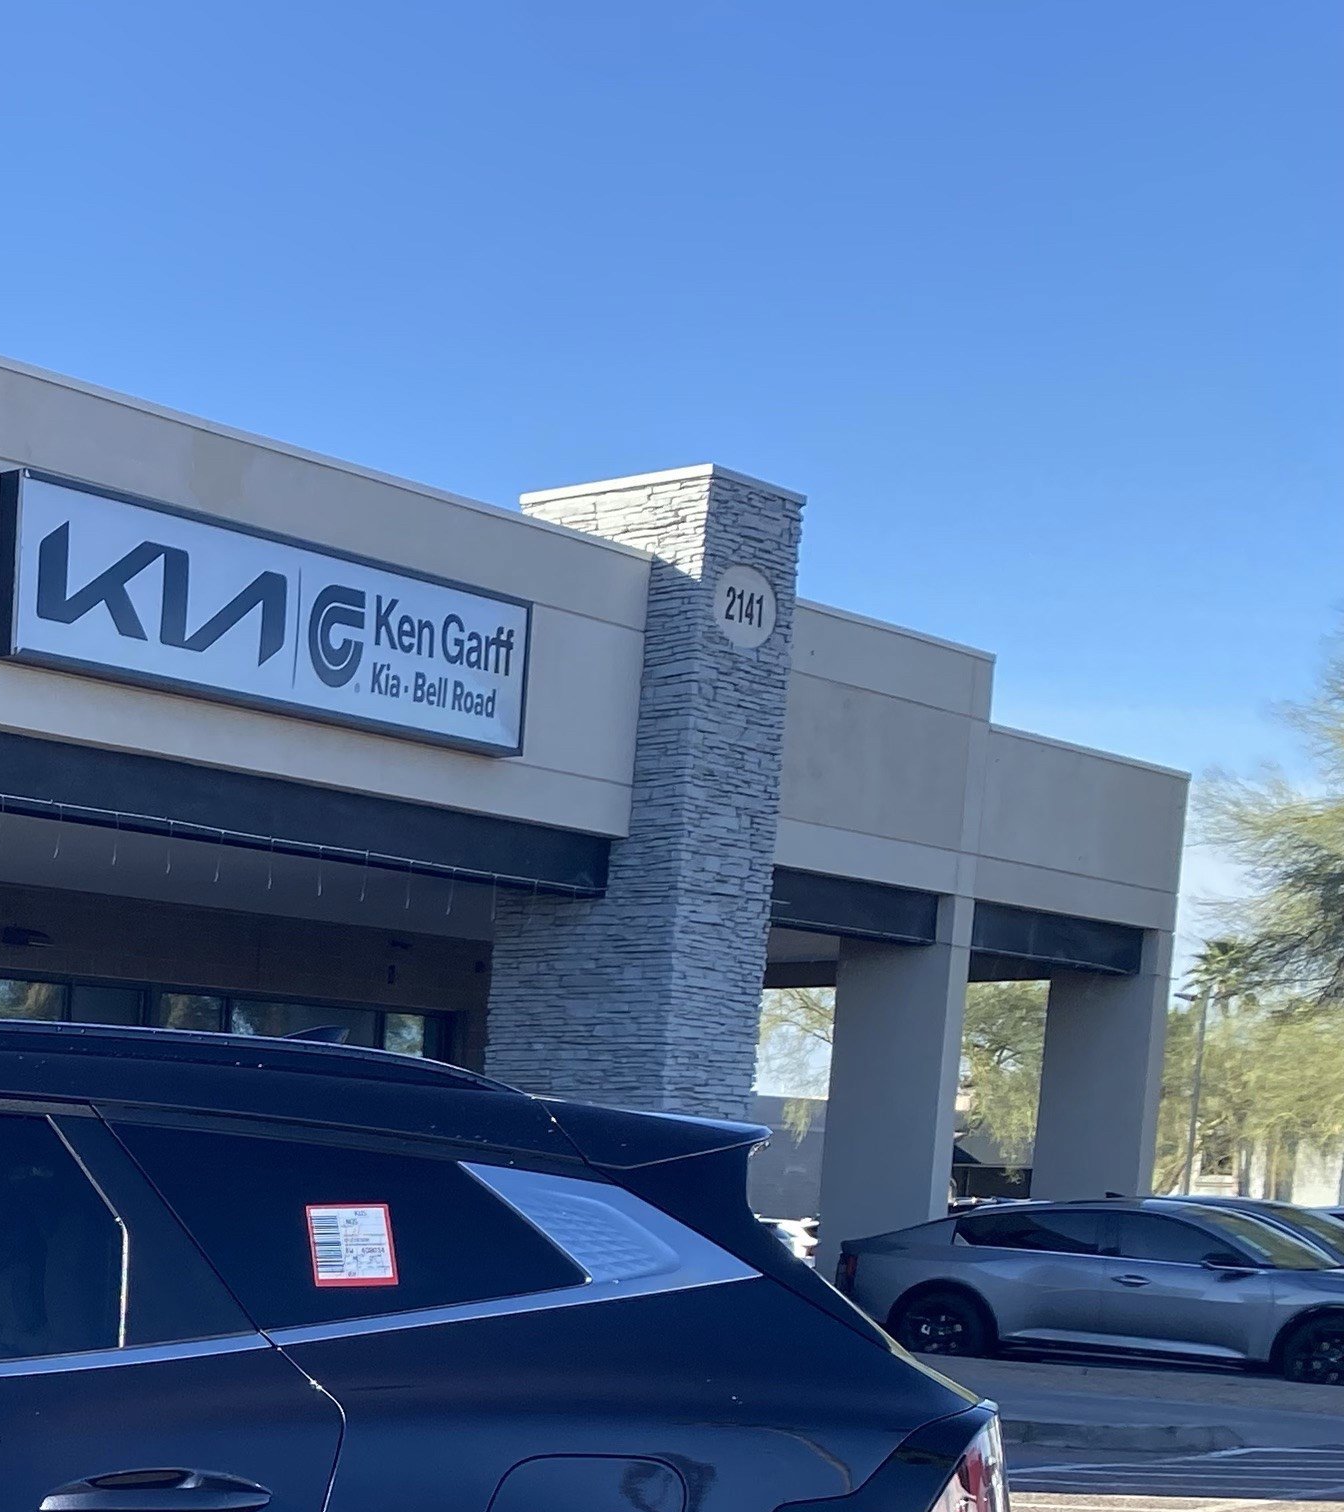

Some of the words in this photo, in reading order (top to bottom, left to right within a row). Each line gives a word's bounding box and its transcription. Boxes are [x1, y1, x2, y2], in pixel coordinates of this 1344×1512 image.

[37, 521, 288, 667] KIA
[725, 586, 764, 628] 2141
[374, 594, 435, 658] Ken
[441, 613, 515, 676] Garff
[370, 661, 401, 698] Kia
[413, 671, 448, 708] Bell
[451, 680, 497, 718] Road
